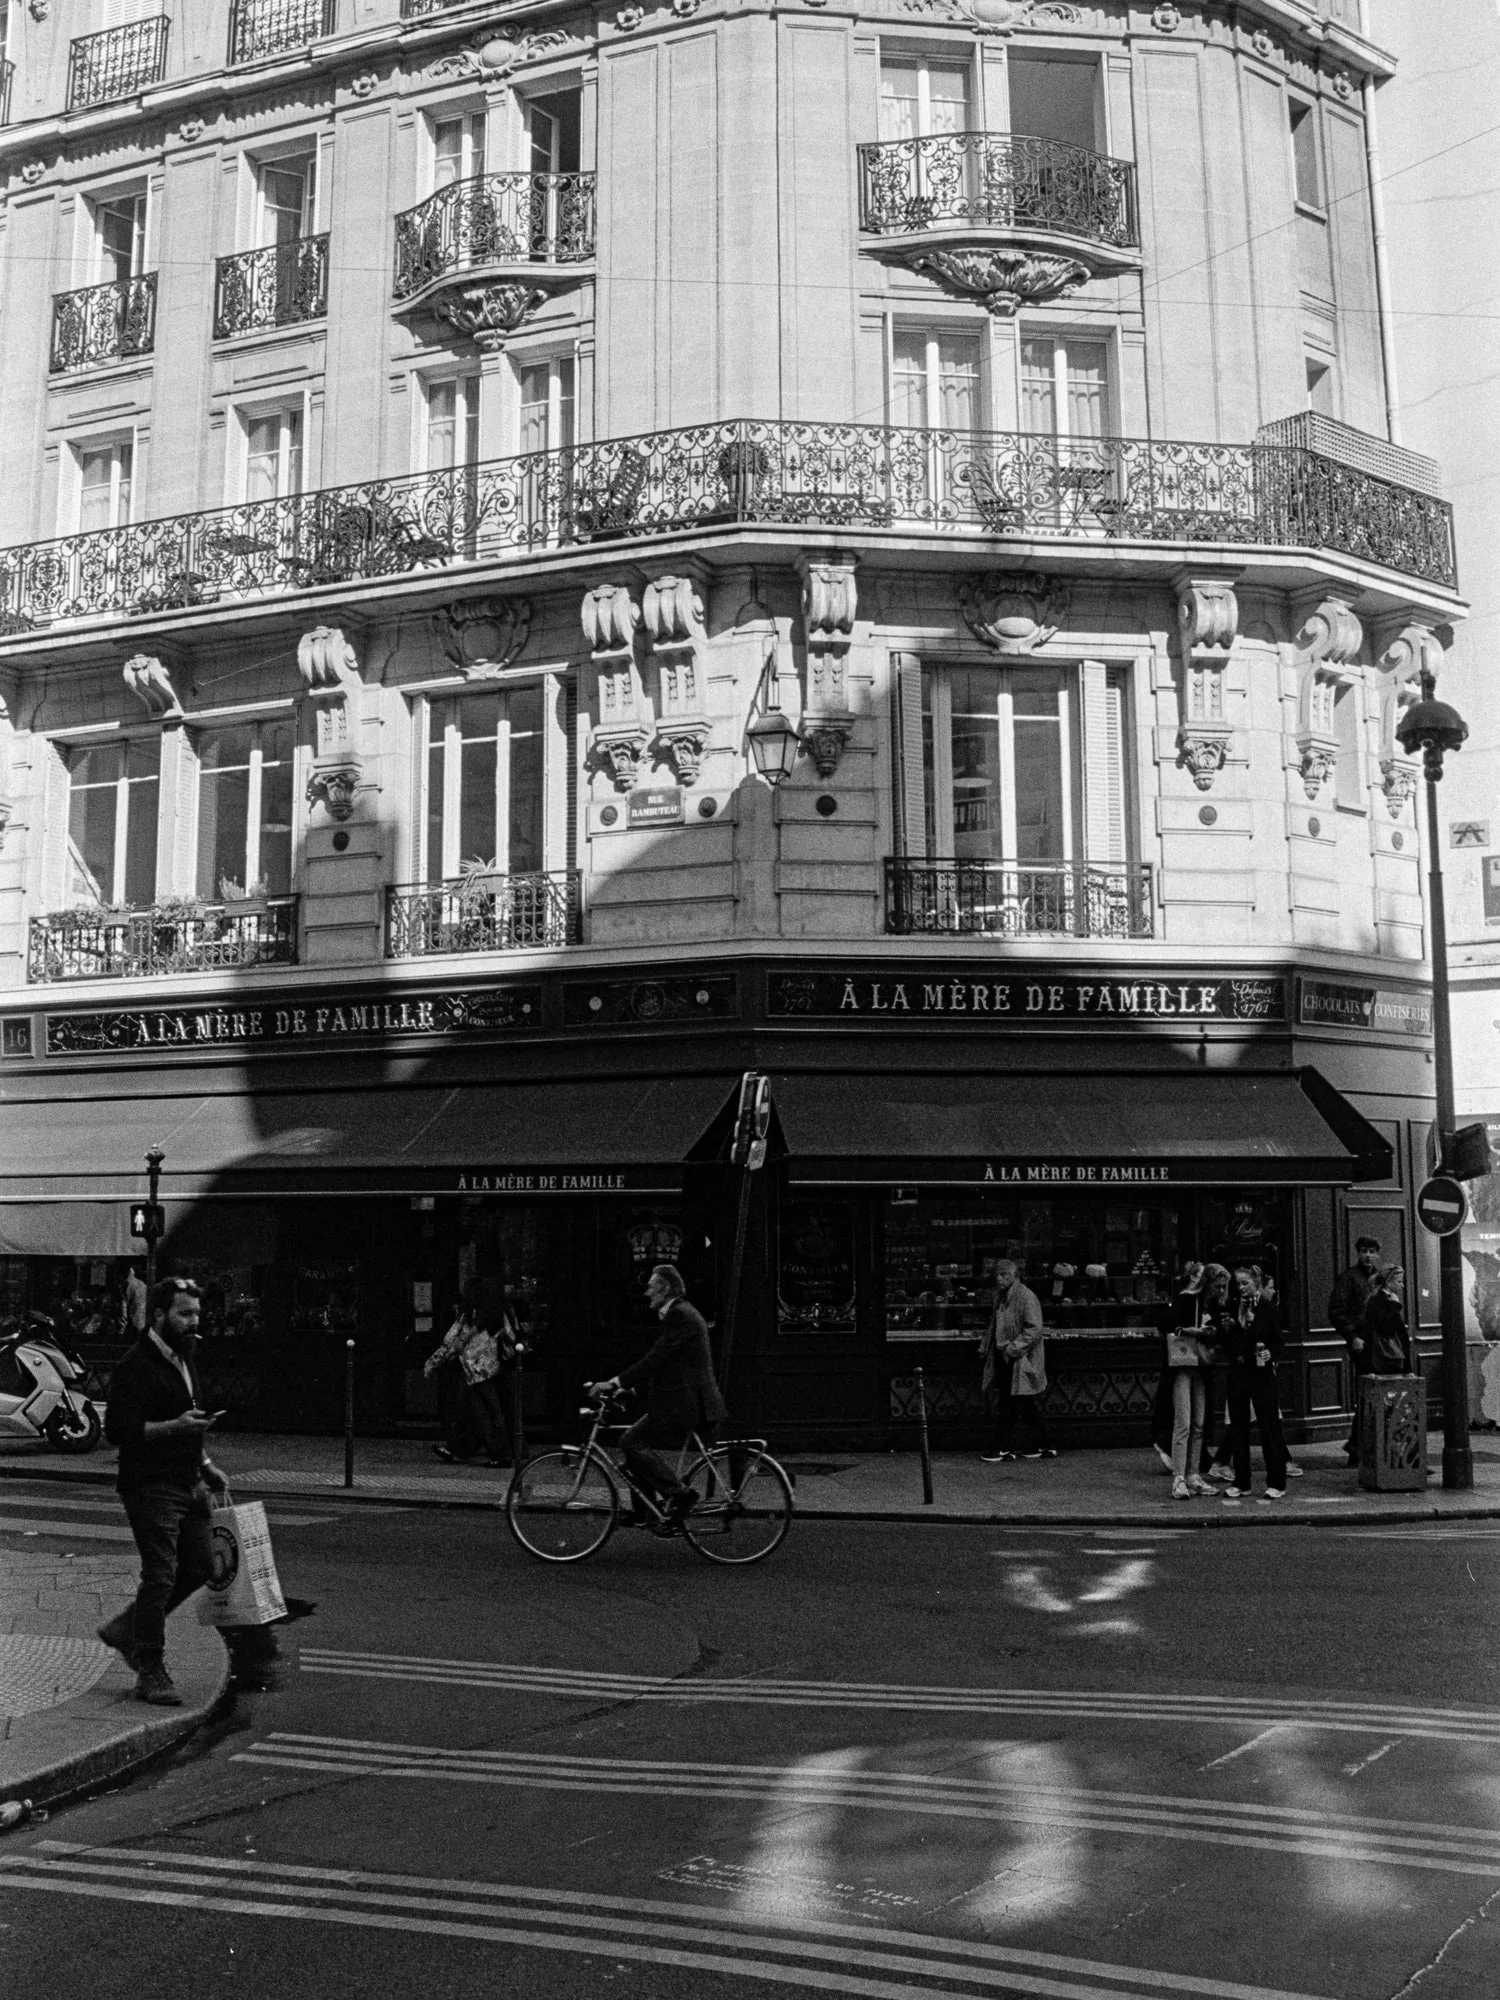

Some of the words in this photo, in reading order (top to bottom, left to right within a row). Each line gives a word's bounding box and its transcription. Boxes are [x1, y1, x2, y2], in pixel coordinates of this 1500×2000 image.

[647, 795, 665, 804] RUE
[631, 805, 681, 817] RAMBUTEAU
[839, 977, 860, 1009] À
[871, 983, 910, 1010] LA
[922, 978, 1011, 1011] MÈRE
[1025, 985, 1064, 1012] DE
[1076, 985, 1217, 1013] FAMILLE
[1238, 981, 1273, 999] Depuis
[1304, 993, 1361, 1015] CHOCOLATS
[1374, 1002, 1430, 1022] CONFISERIES
[135, 1014, 151, 1042] À
[154, 1017, 188, 1041] LA
[195, 1008, 263, 1039] MÈRE
[275, 1009, 307, 1035] DE
[316, 1001, 434, 1032] FAMILLE
[8, 1026, 28, 1047] 16
[457, 1173, 467, 1189] À
[472, 1176, 490, 1189] LA
[495, 1173, 535, 1189] MÈRE
[539, 1175, 558, 1189] DE
[562, 1174, 625, 1189] FAMILLE
[984, 1163, 995, 1181] À
[1000, 1167, 1021, 1181] LA
[1027, 1163, 1071, 1181] MÈRE
[1076, 1167, 1096, 1181] DE
[1101, 1167, 1169, 1181] FAMILLE
